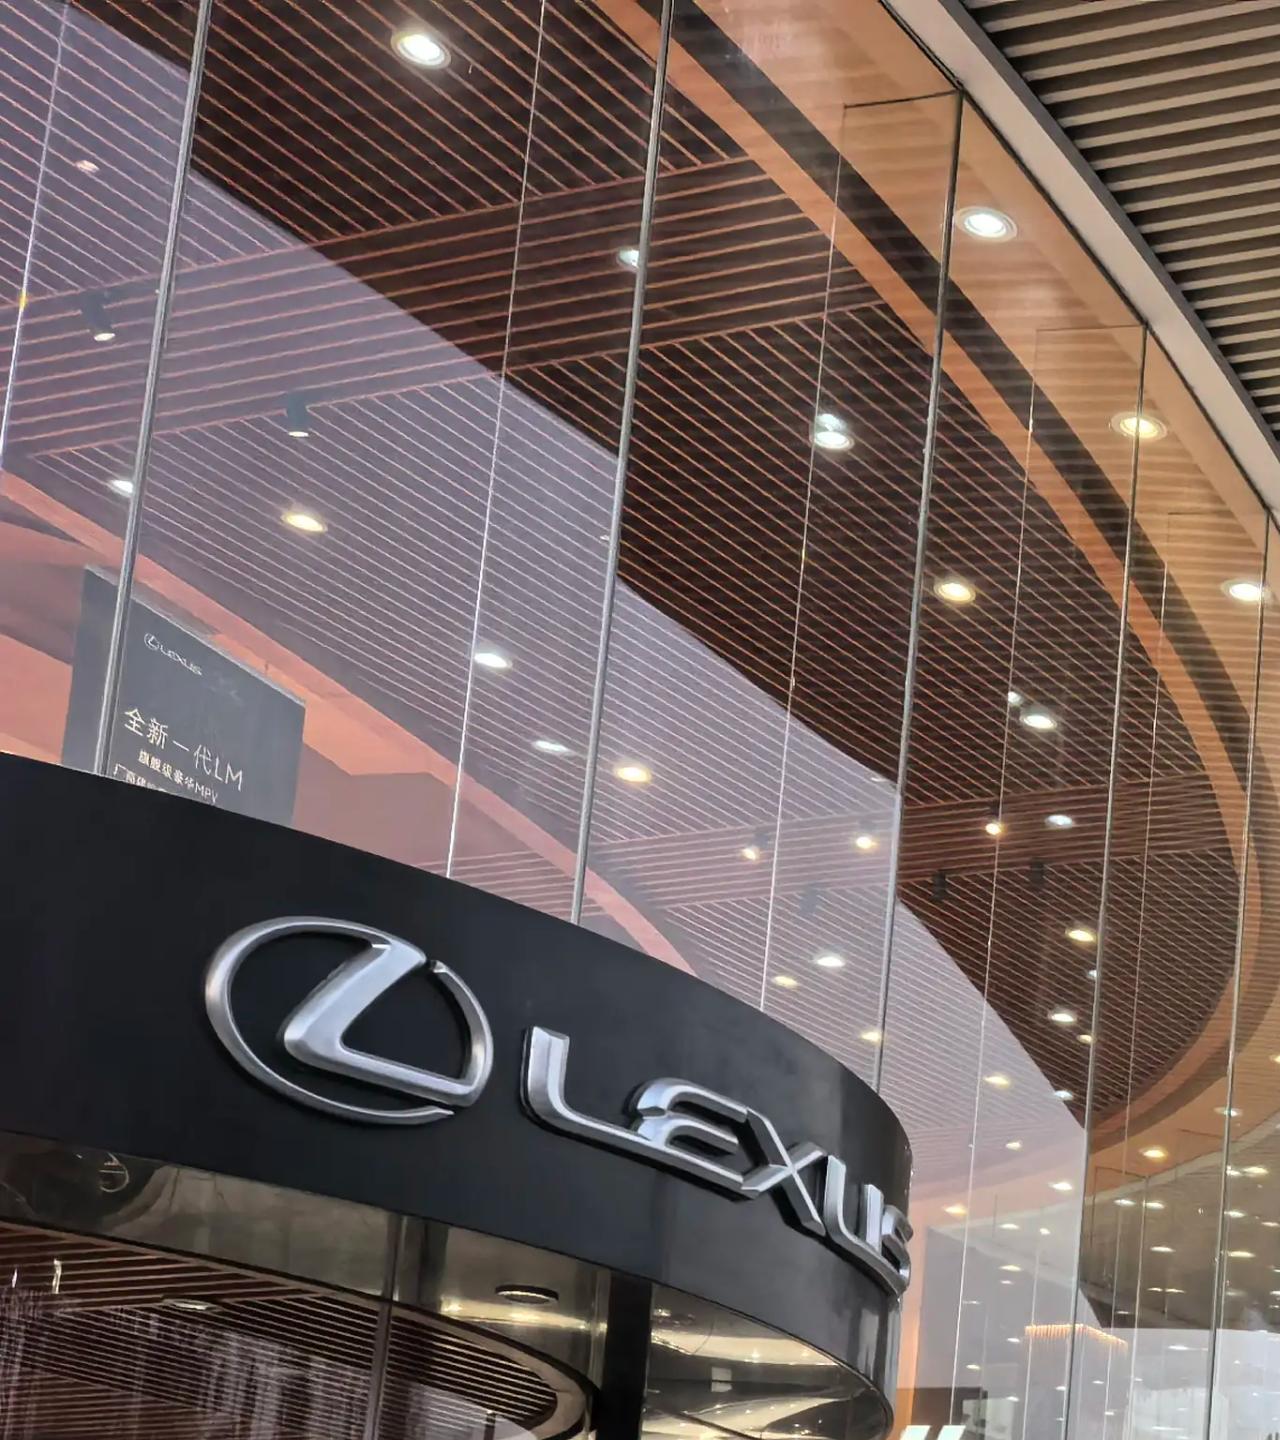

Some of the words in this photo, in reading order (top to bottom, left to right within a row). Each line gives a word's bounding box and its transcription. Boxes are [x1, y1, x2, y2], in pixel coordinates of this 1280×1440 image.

[160, 645, 203, 676] LEXUS
[124, 708, 243, 791] 全新一代LM
[521, 1025, 913, 1297] LEXUS
